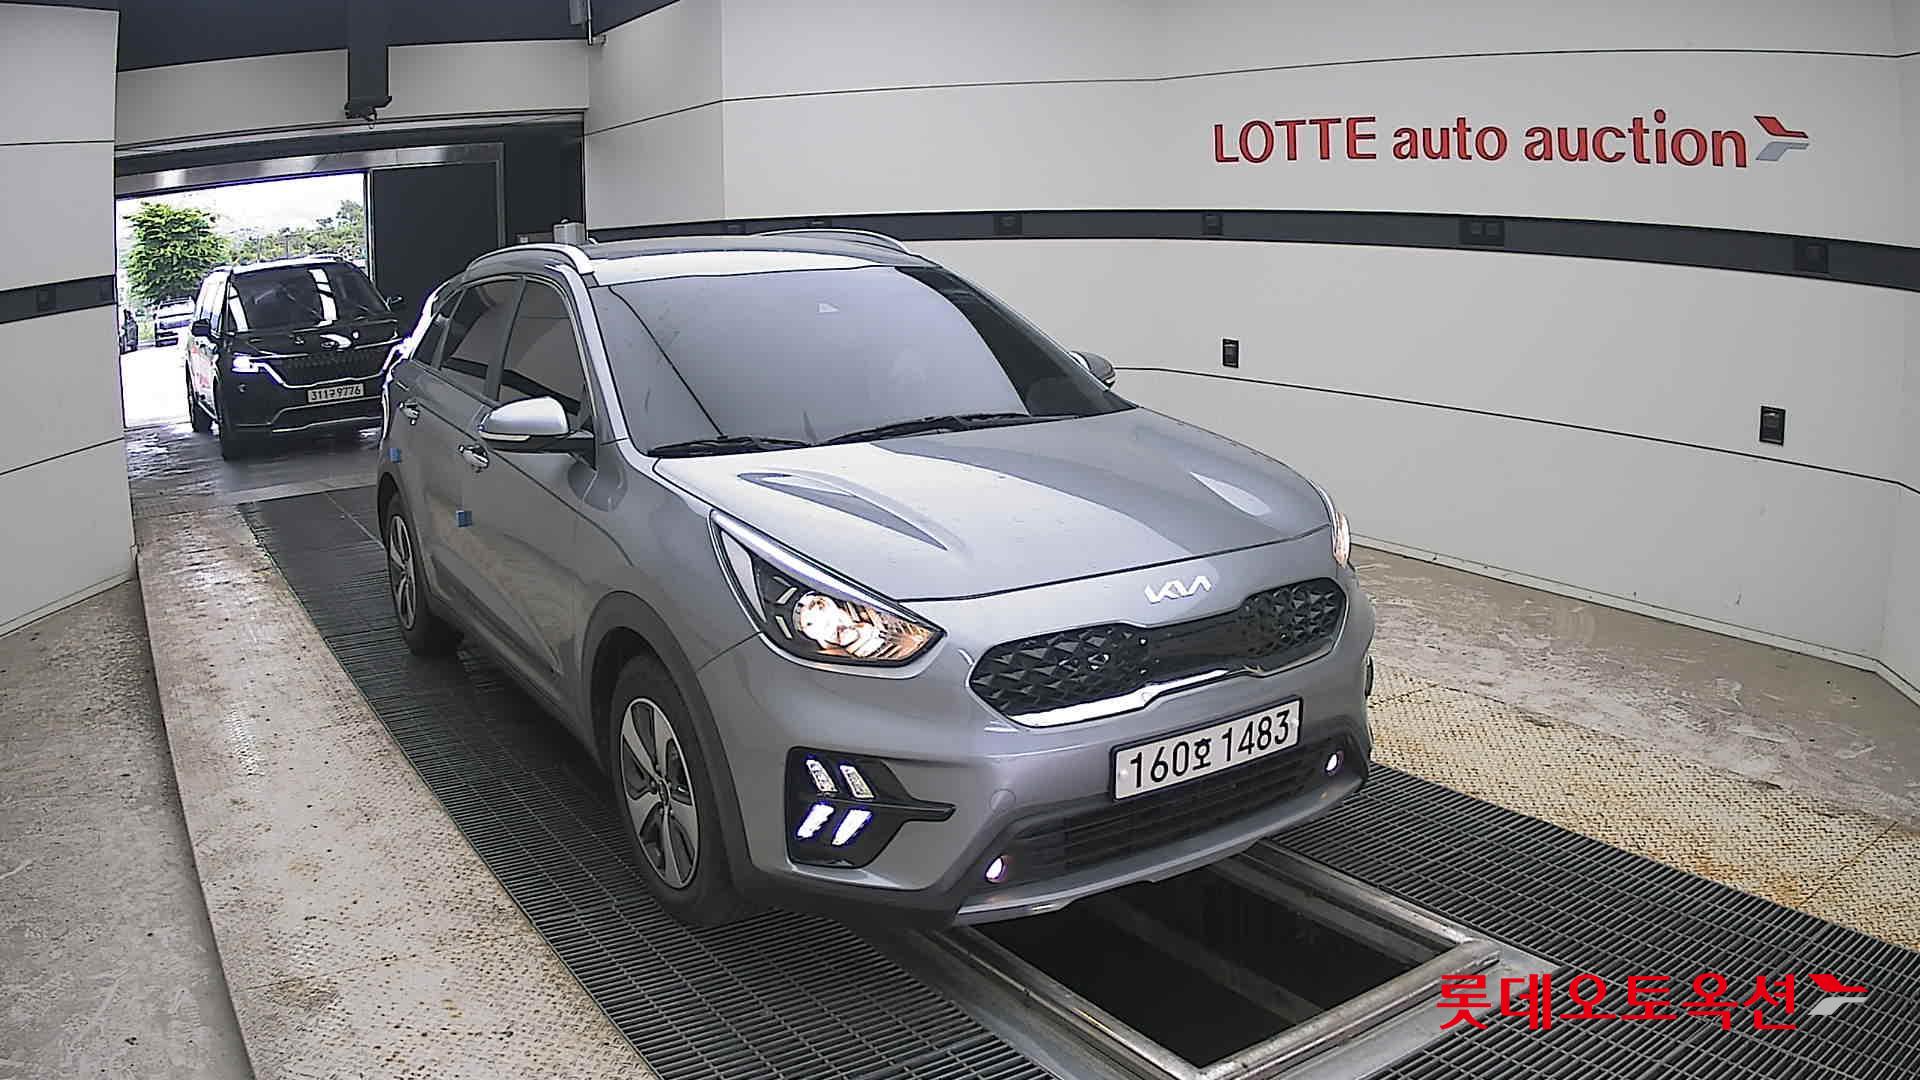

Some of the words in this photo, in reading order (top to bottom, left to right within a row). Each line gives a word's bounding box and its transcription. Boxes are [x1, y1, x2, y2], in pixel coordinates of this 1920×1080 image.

[1214, 116, 1377, 164] LOTTE
[1392, 117, 1508, 162] auto
[1524, 109, 1748, 168] auction
